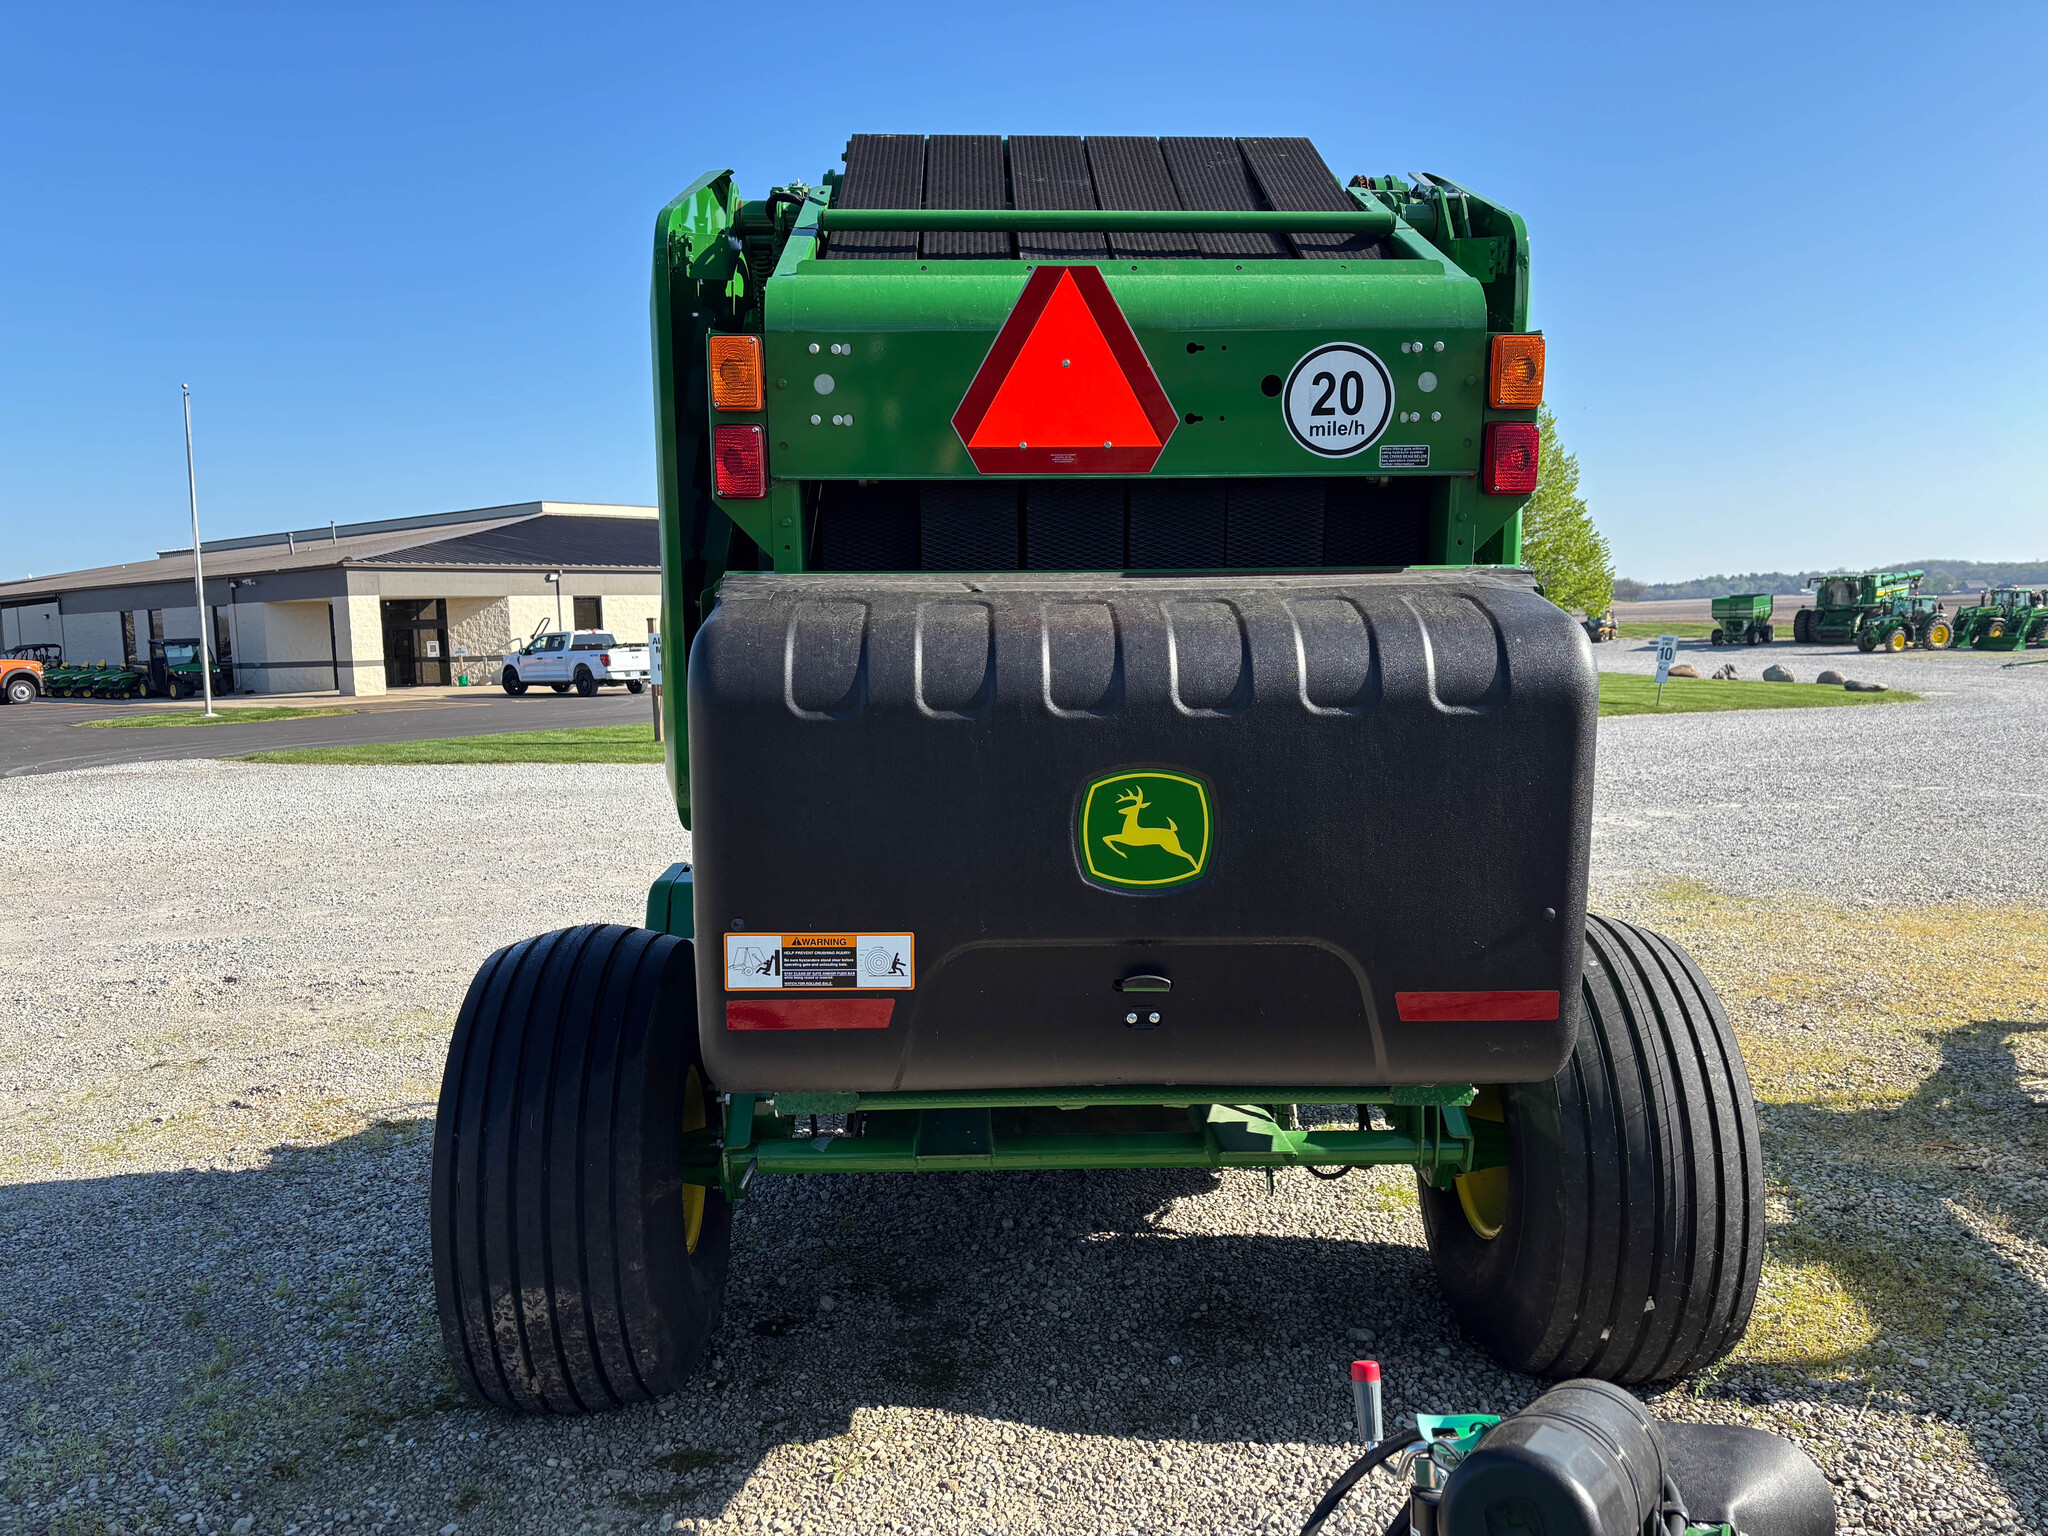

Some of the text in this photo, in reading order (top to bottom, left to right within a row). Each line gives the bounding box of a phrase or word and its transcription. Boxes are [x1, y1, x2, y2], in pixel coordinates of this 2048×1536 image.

[1311, 371, 1364, 416] 20
[1310, 420, 1365, 437] mile/h
[1659, 647, 1673, 660] 10
[802, 938, 847, 946] WARNING
